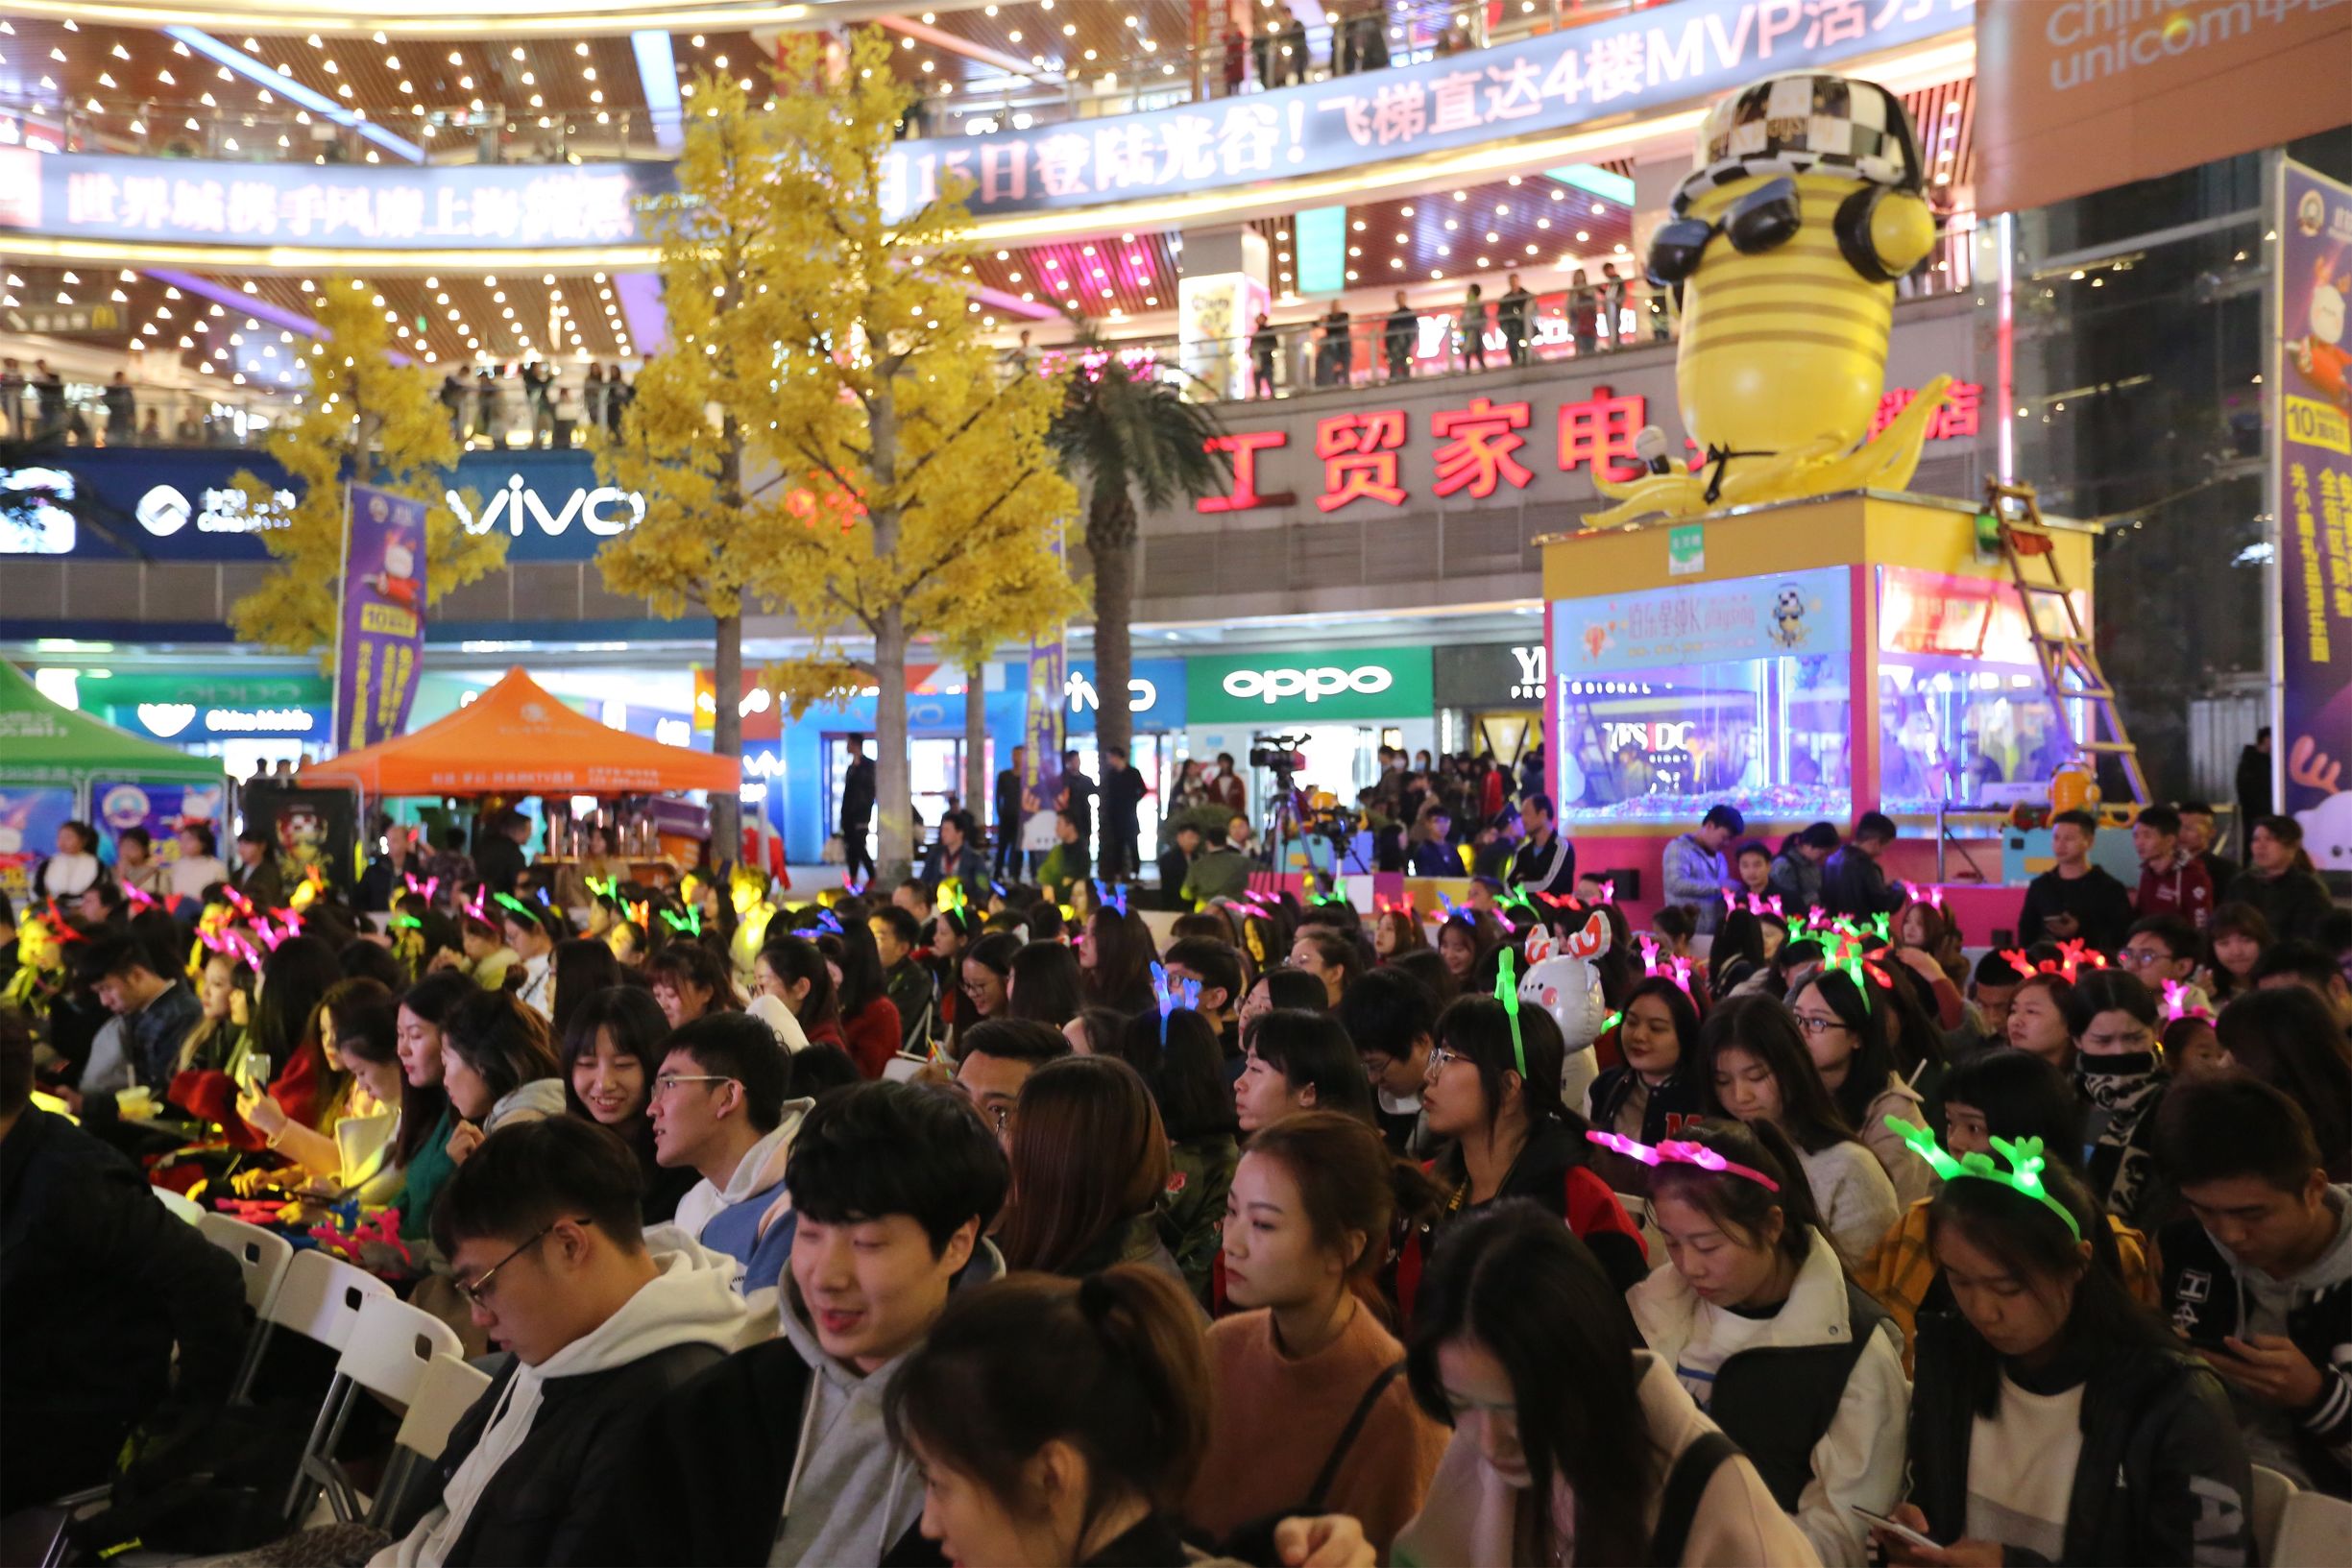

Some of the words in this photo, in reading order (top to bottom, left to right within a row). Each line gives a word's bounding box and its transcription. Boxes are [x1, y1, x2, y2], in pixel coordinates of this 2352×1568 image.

[1197, 387, 1647, 512] 工贸家电
[1223, 664, 1393, 704] oppo
